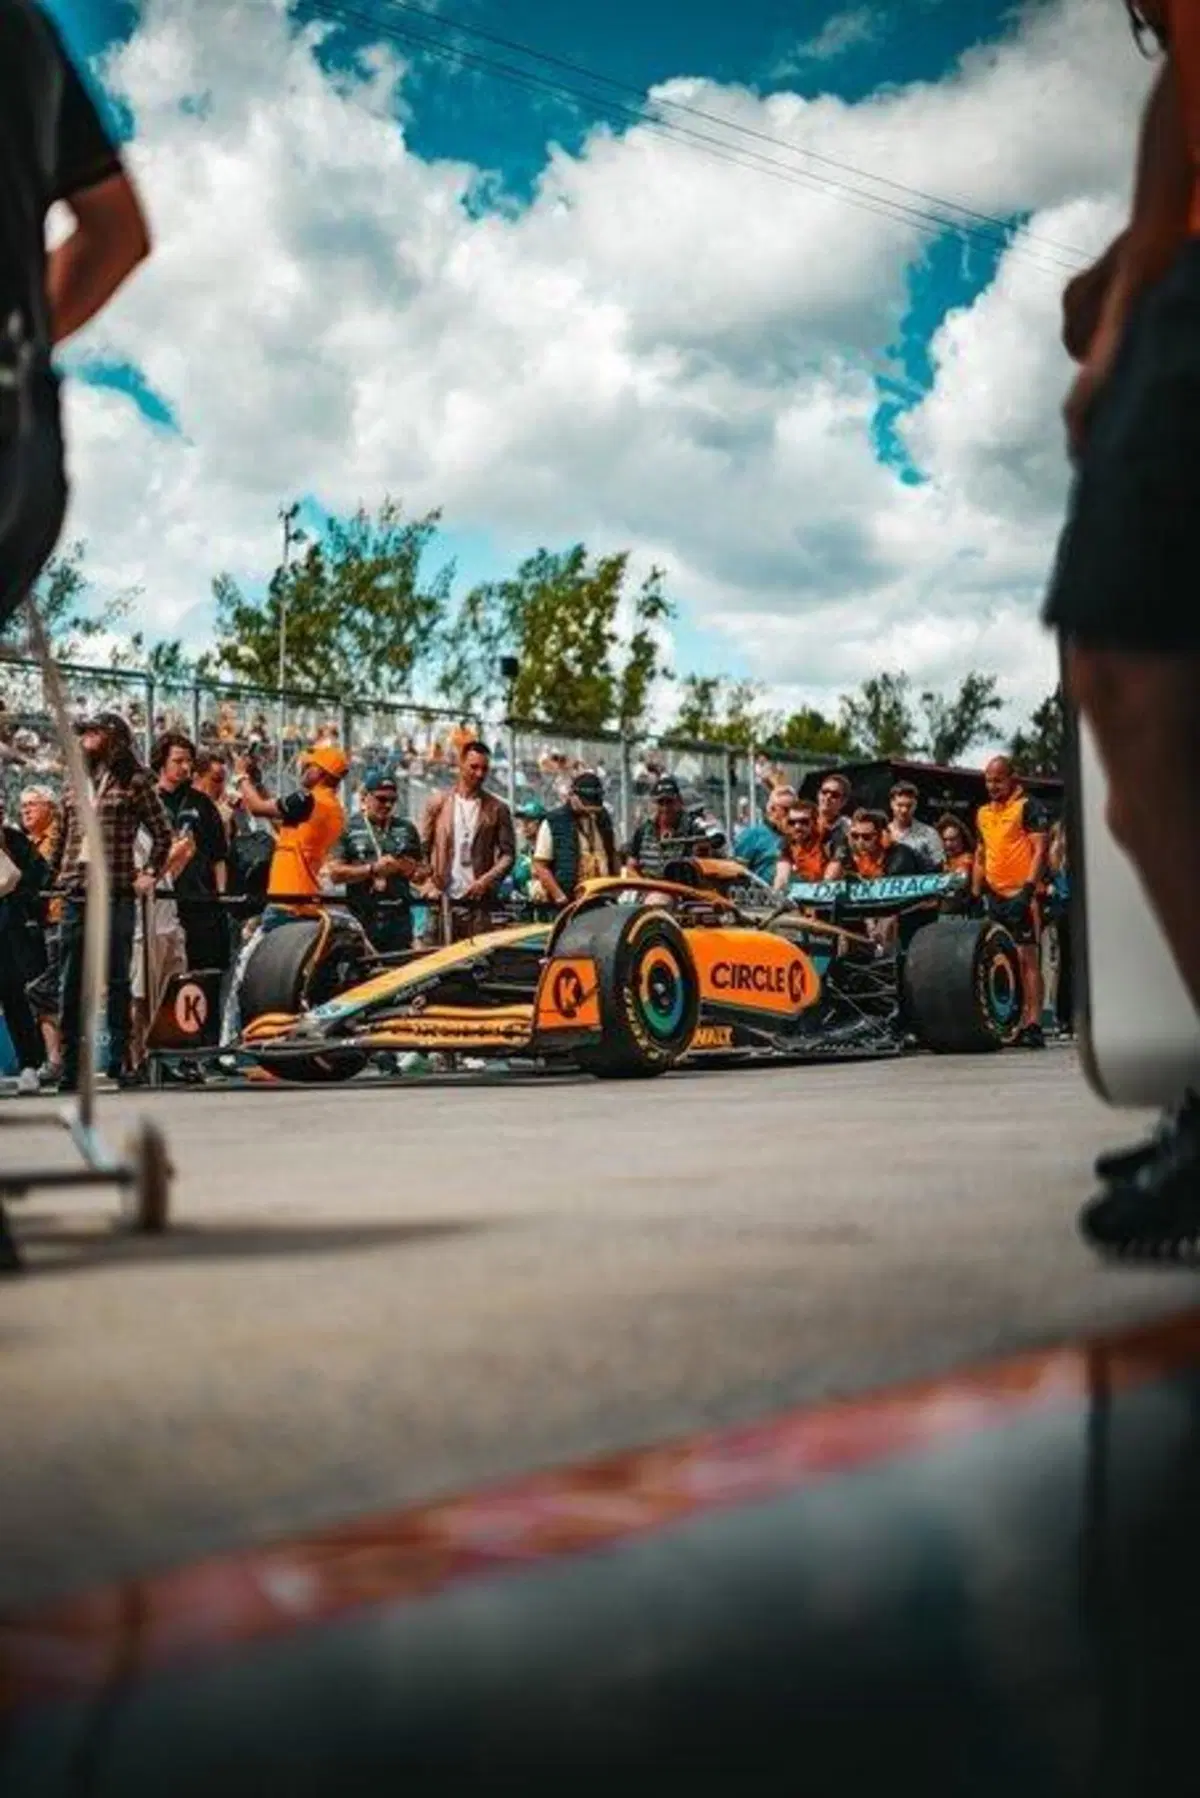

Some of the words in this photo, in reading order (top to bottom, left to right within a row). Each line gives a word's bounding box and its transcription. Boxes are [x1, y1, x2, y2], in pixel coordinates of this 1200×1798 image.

[710, 961, 786, 993] CIRCLE
[184, 994, 204, 1027] K
[556, 972, 581, 1016] K
